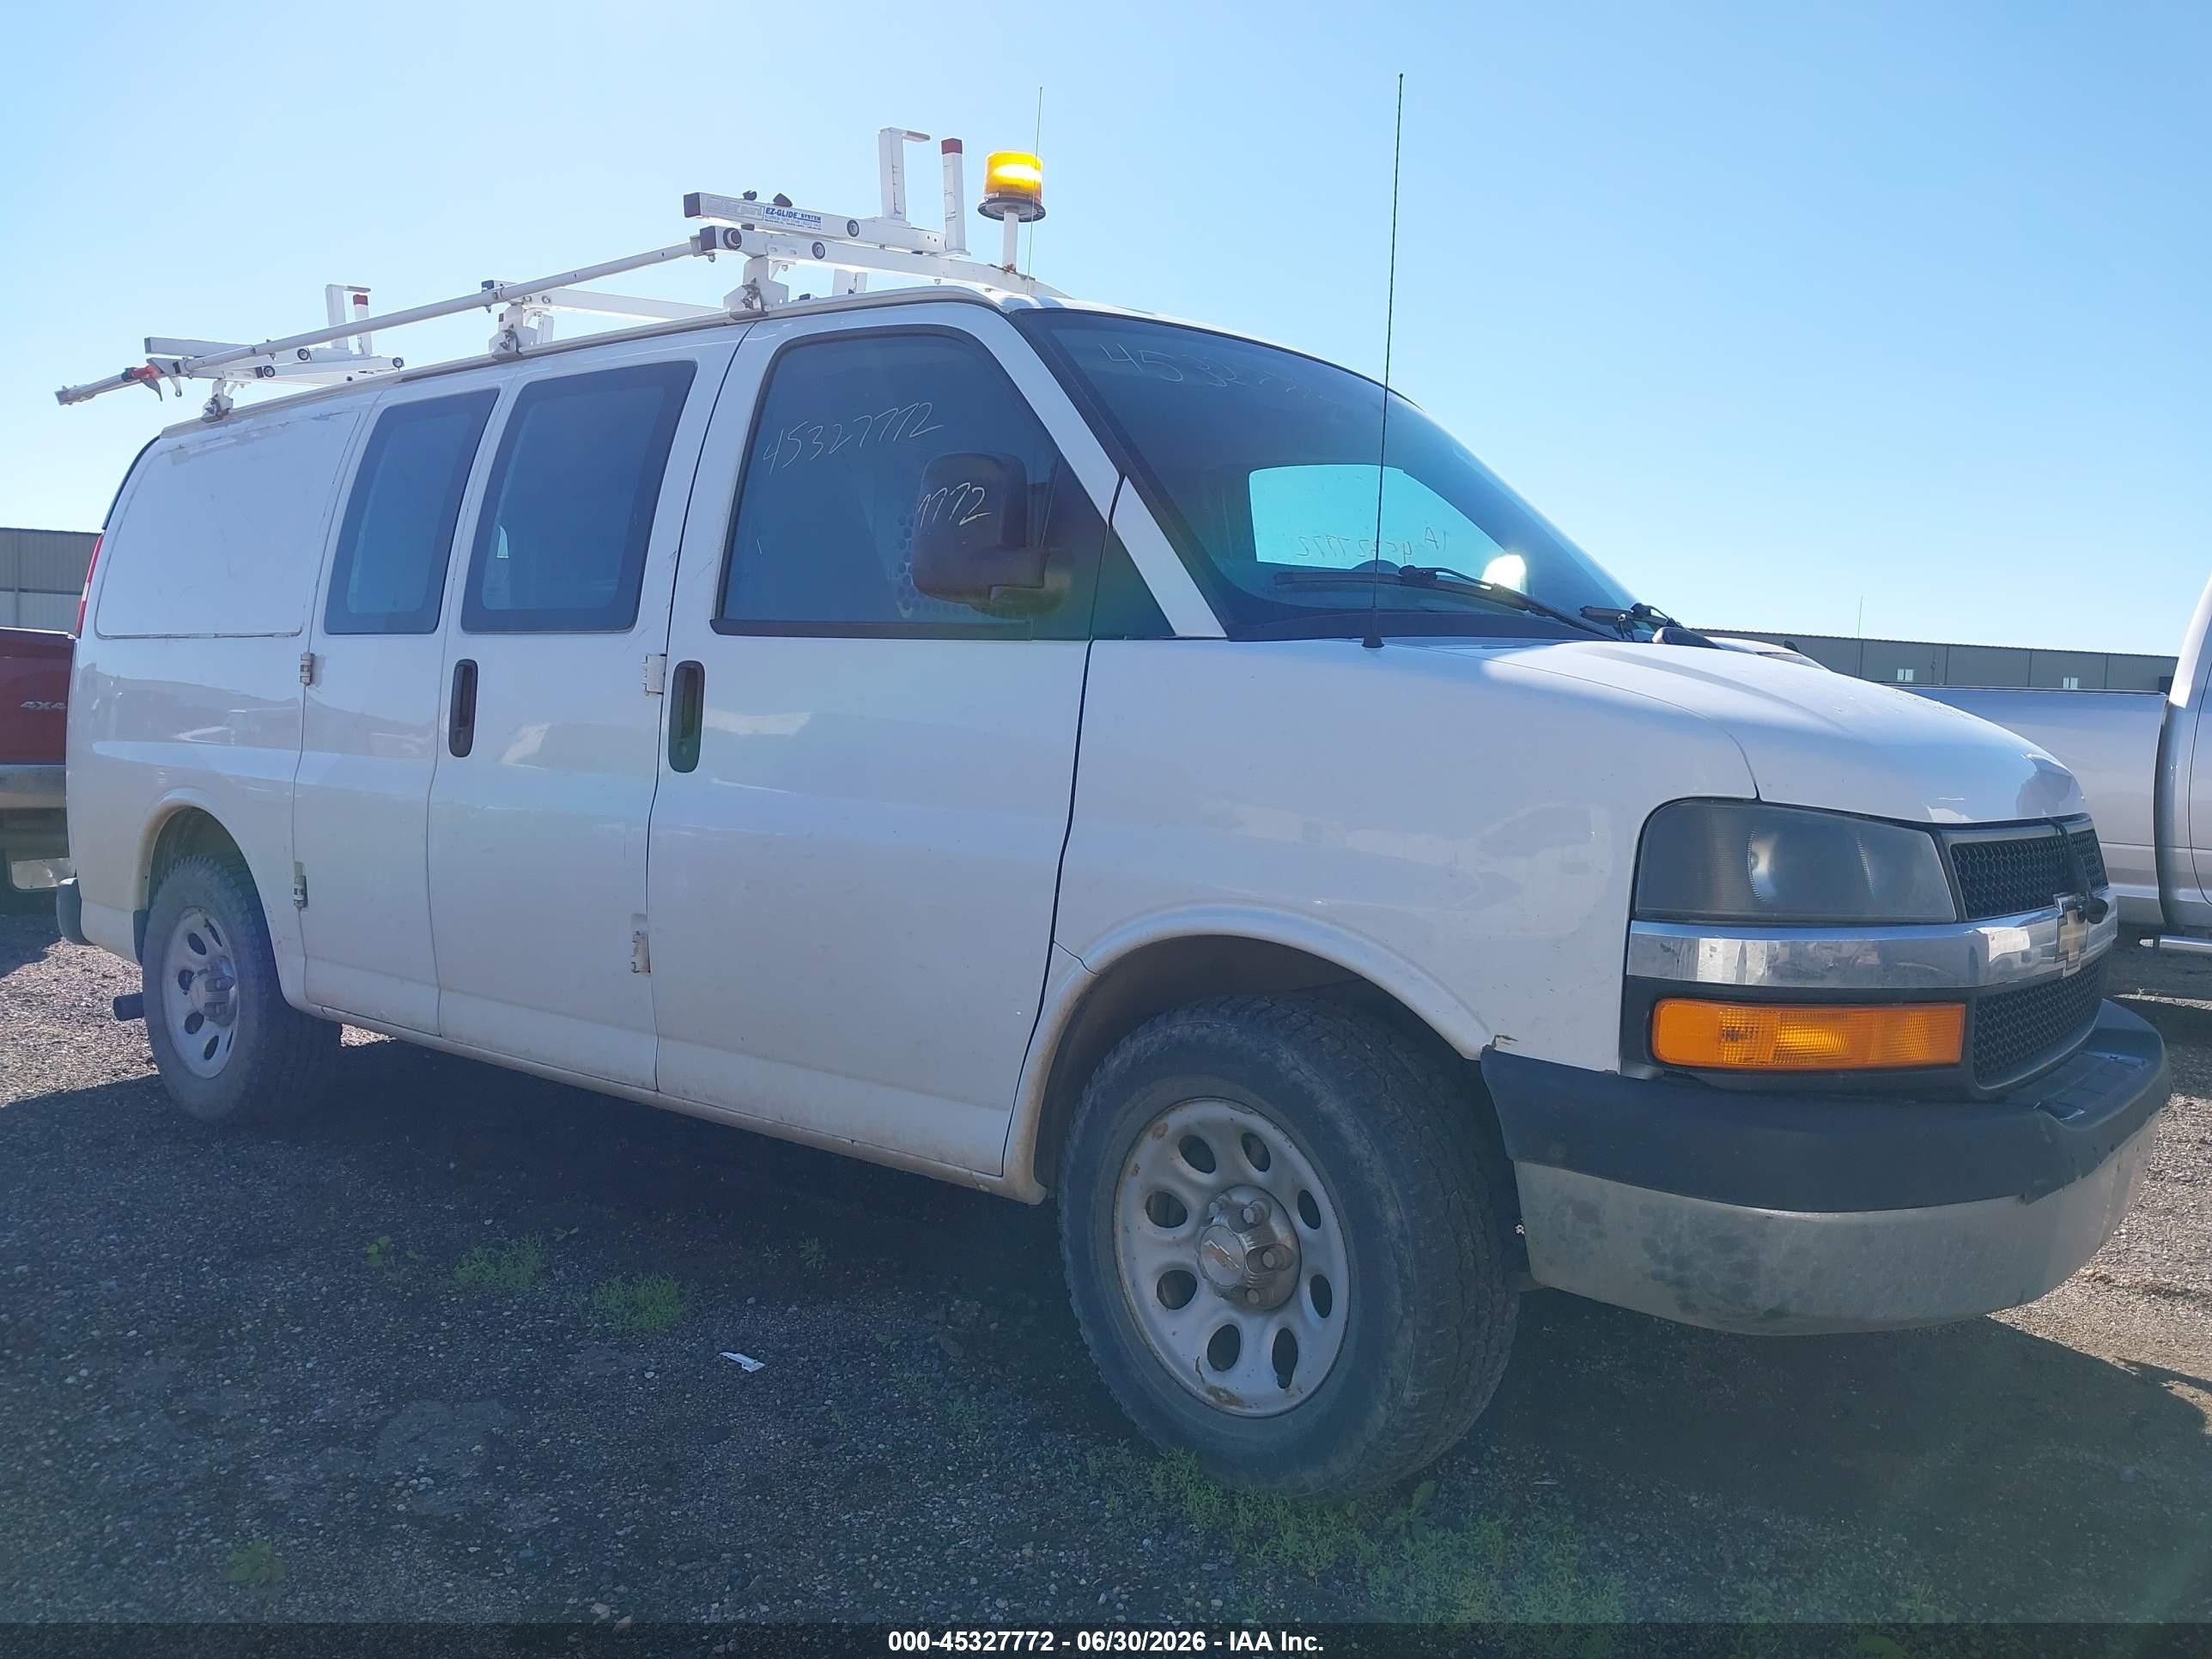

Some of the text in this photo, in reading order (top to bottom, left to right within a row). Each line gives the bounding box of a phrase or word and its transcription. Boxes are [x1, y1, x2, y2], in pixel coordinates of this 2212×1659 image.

[766, 206, 822, 222] EZ-GLIDE SYSTEM
[763, 402, 944, 475] 45327772
